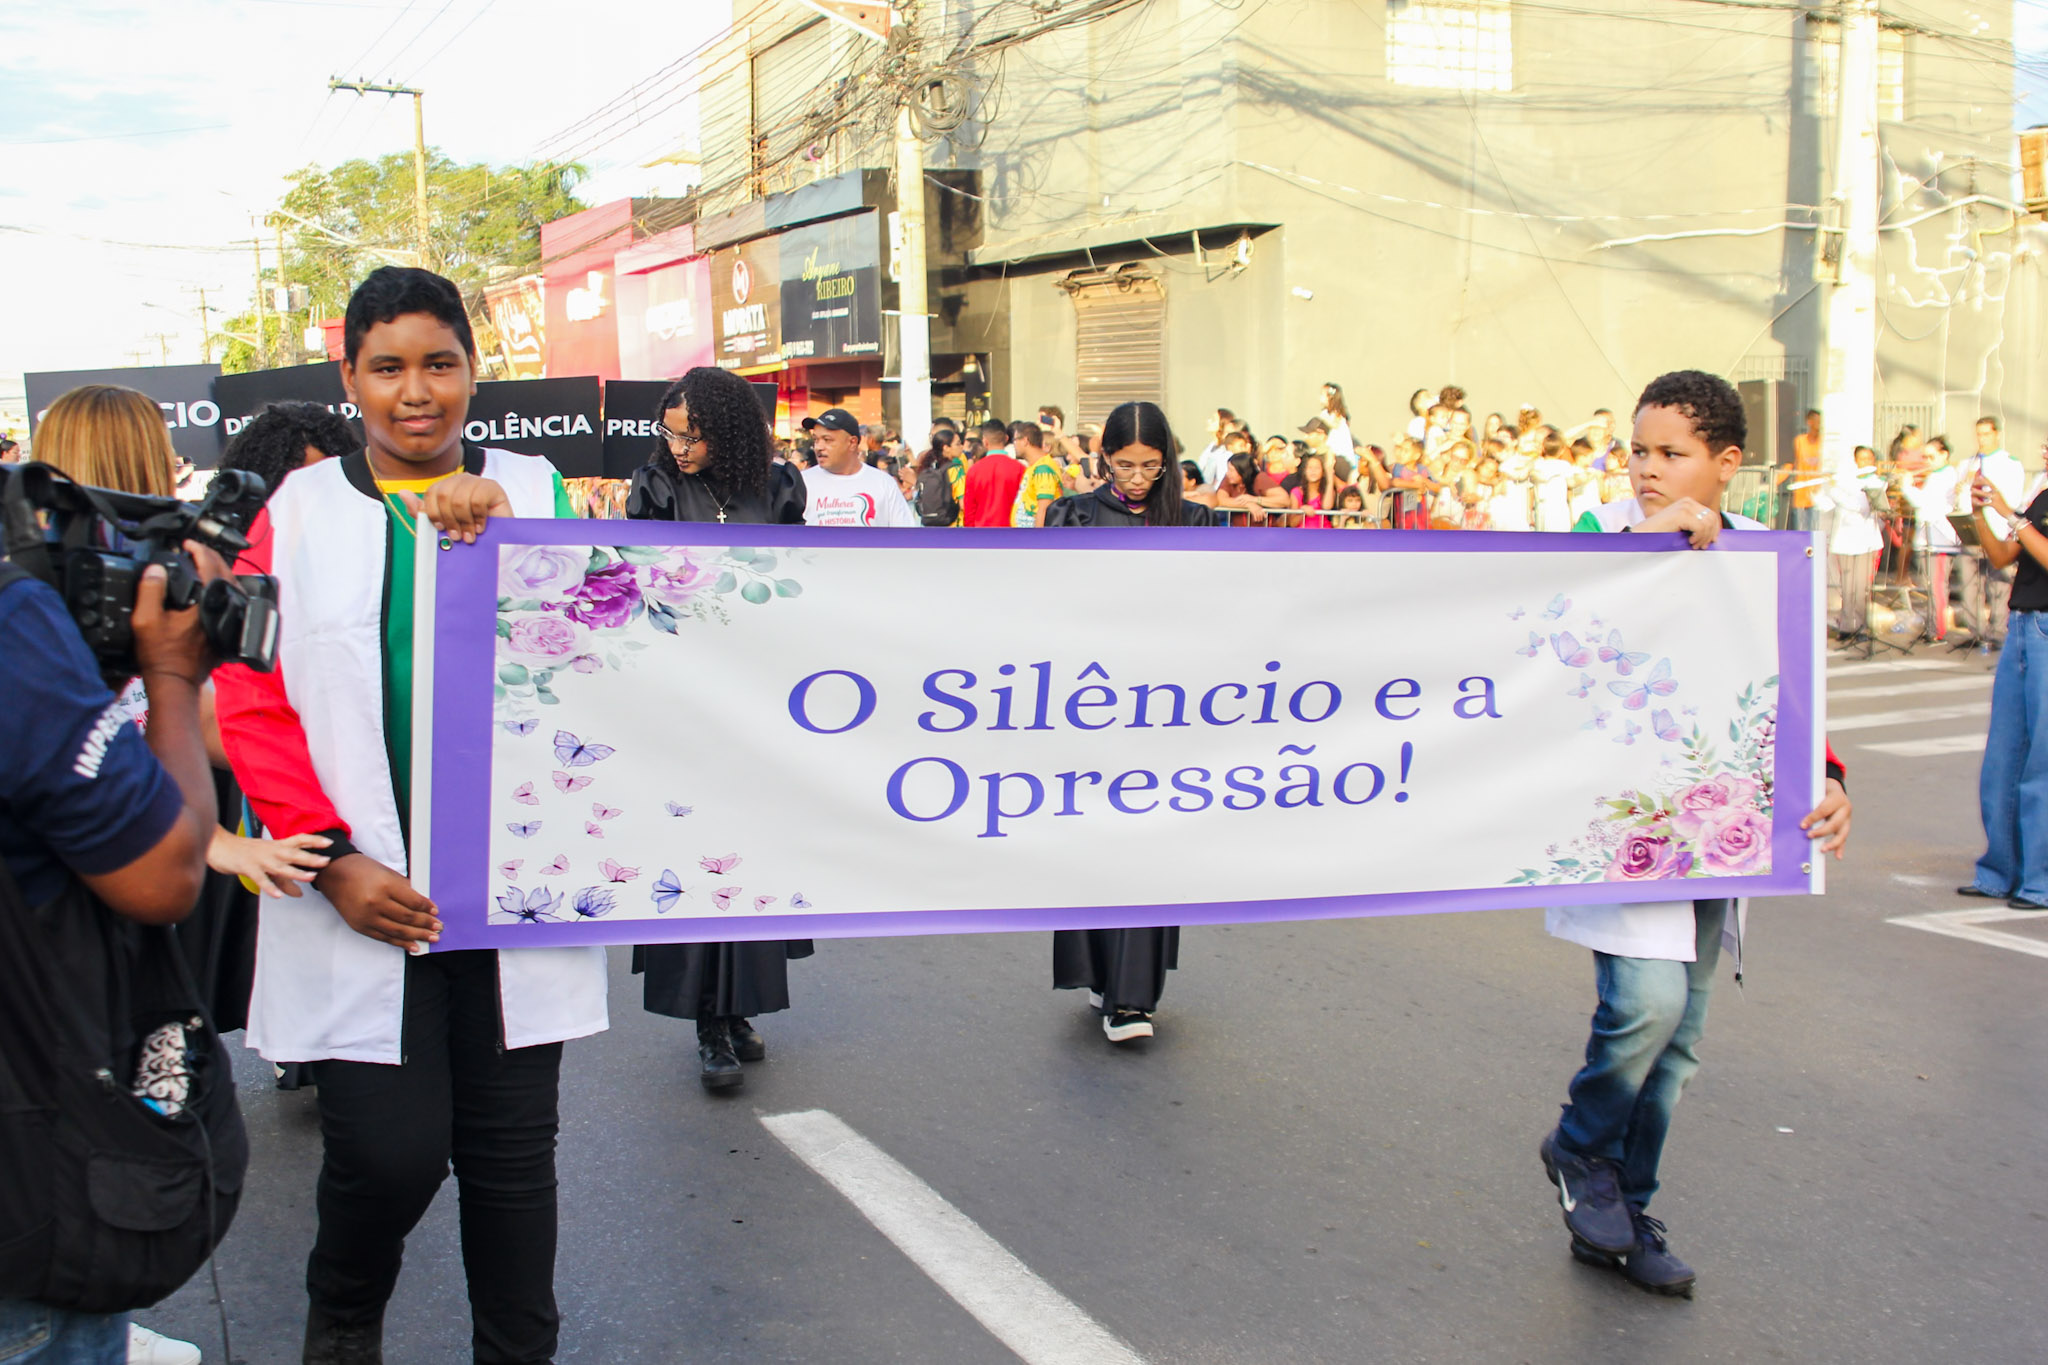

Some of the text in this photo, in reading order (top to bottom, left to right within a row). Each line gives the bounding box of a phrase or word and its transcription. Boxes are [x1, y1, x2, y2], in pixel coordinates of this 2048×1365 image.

[816, 275, 855, 301] RIBEIRO
[461, 411, 594, 442] OLÊNCIA
[816, 496, 855, 511] Mulheres
[788, 661, 1503, 735] O Silêncio e a
[886, 742, 1413, 839] Opressão!
